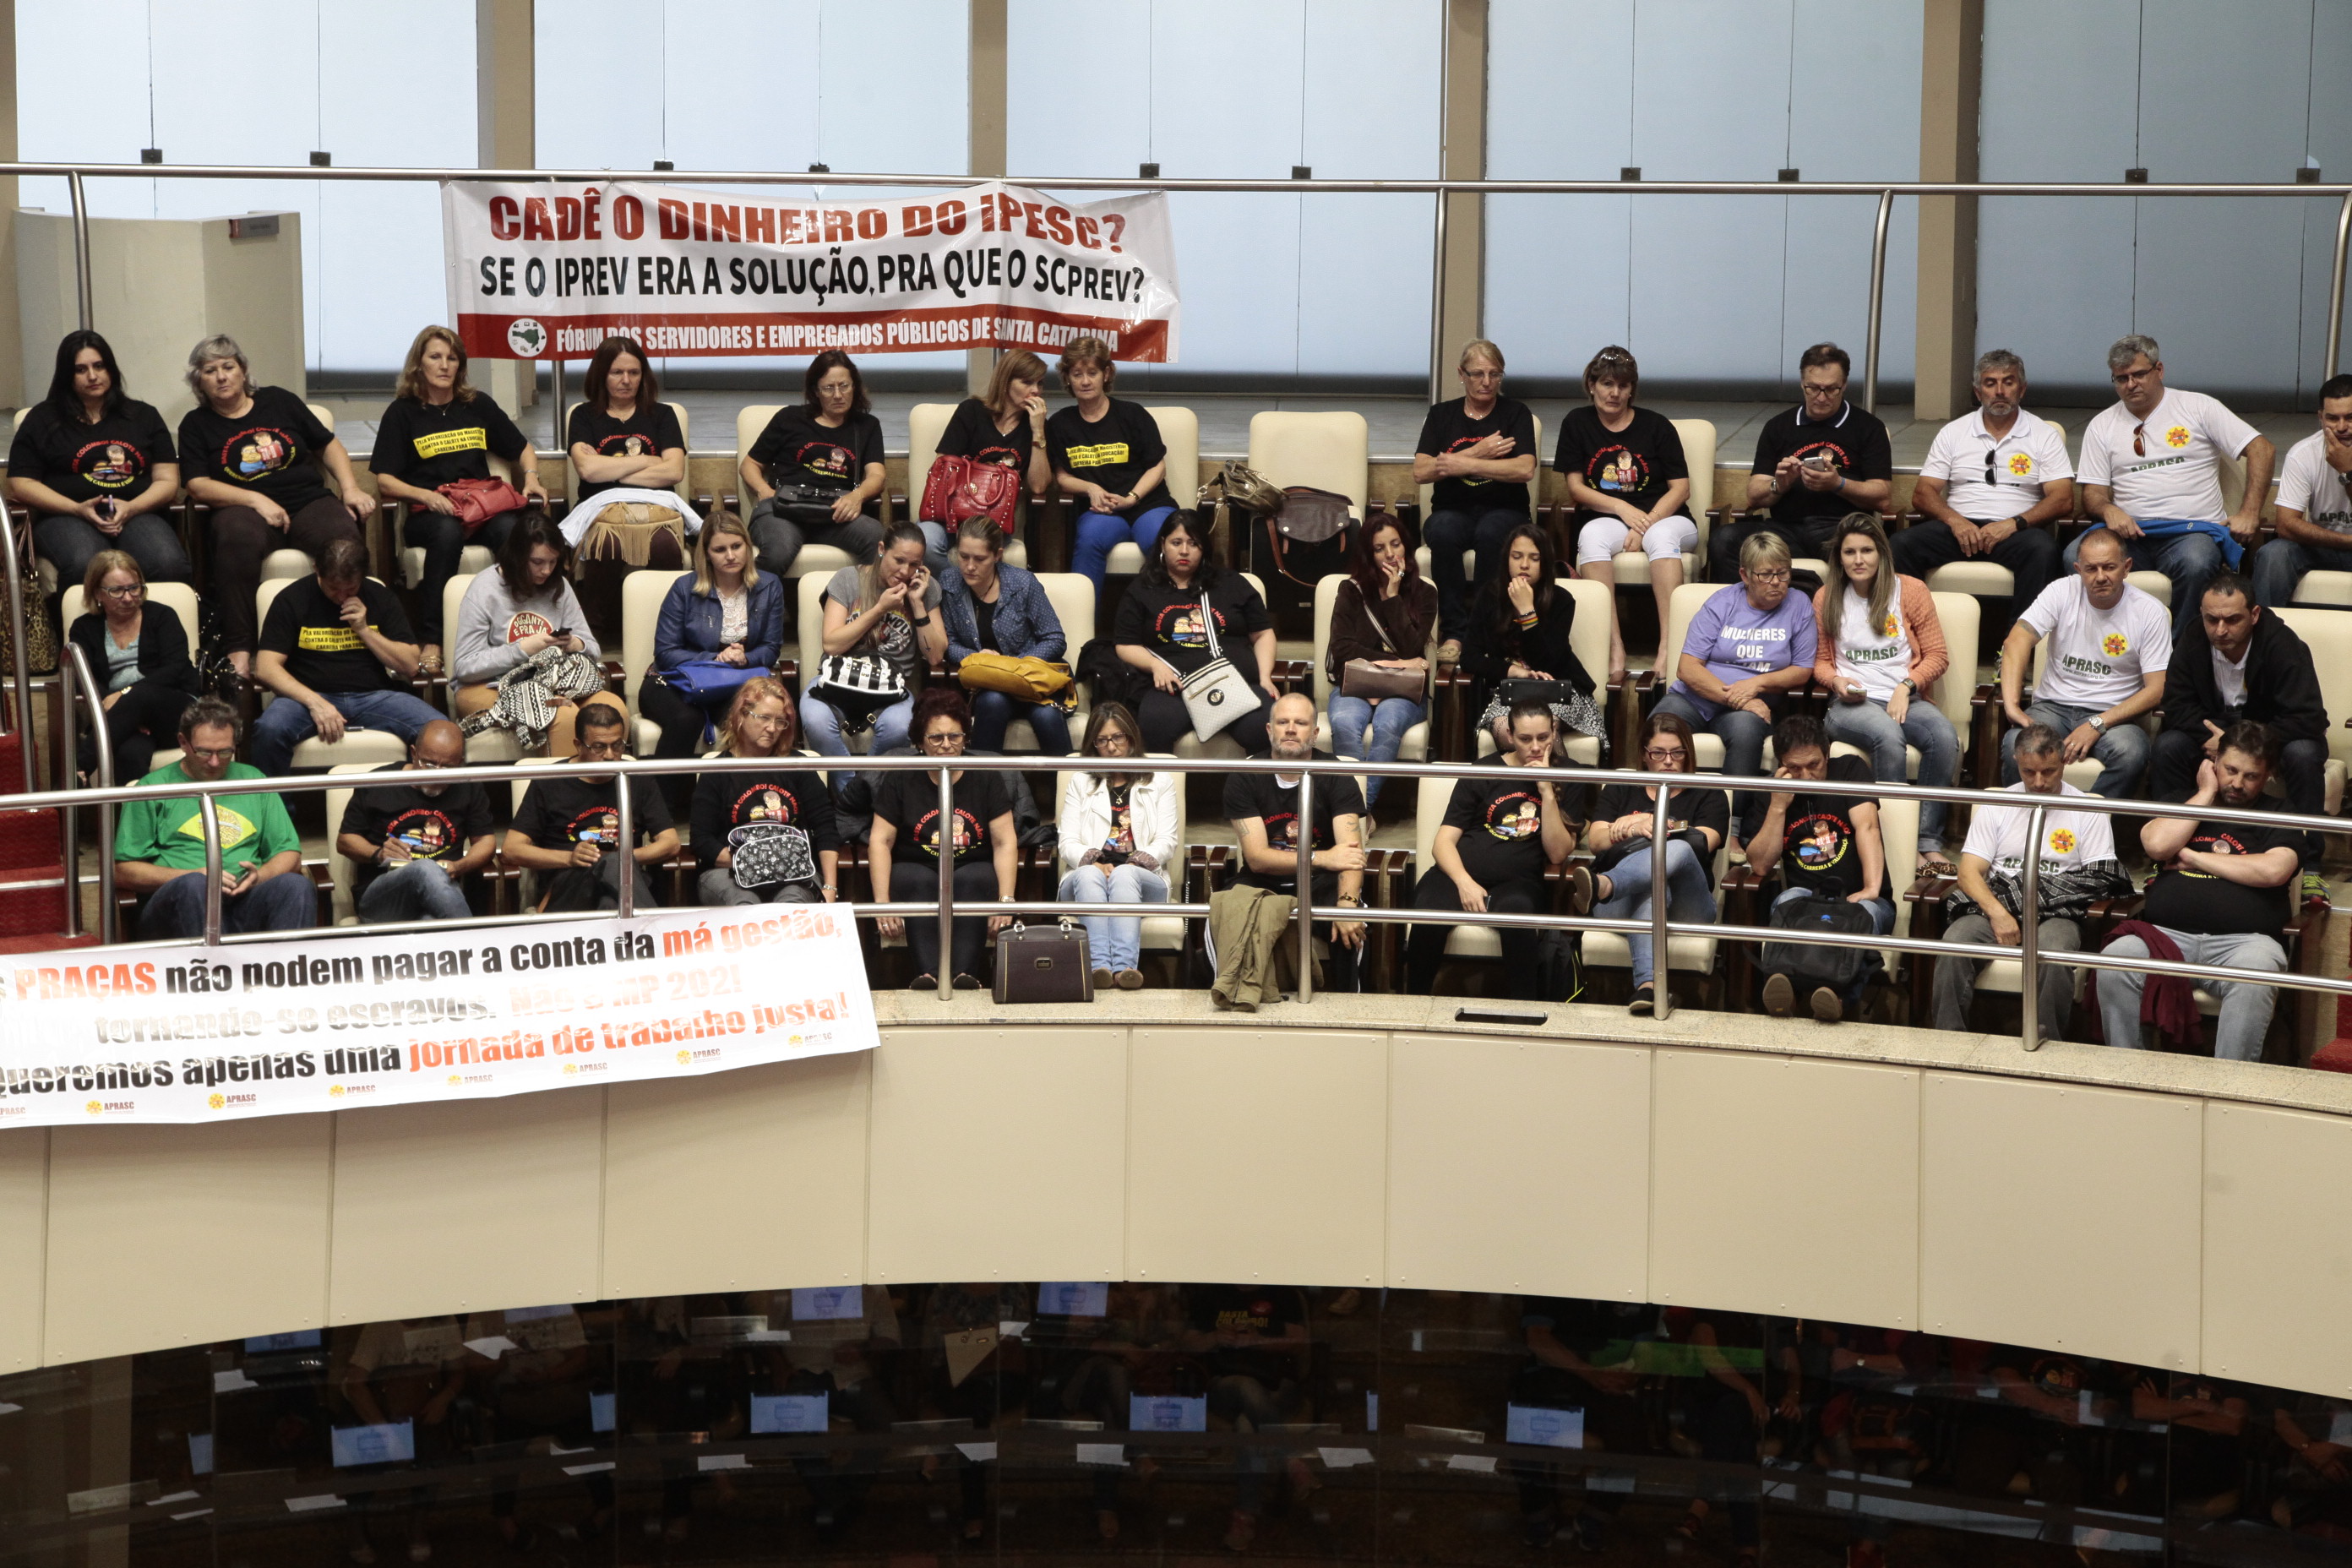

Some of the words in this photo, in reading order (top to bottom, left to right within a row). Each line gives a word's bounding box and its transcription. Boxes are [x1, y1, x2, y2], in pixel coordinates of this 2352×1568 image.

[488, 188, 602, 241] CADÊ
[612, 195, 644, 240] O
[658, 197, 888, 244] DINHEIRO
[901, 199, 966, 237] DO
[980, 192, 1126, 253] IPESC?
[480, 255, 515, 297] SE
[525, 257, 546, 297] O
[556, 256, 629, 297] IPREV
[638, 256, 696, 296] ERA
[702, 257, 723, 295] A
[944, 248, 1002, 299] QUE
[1008, 249, 1026, 288] O
[1032, 253, 1144, 304] SCPREV?
[557, 324, 603, 352] FÓRUM
[645, 325, 753, 350] SERVIDORES
[757, 326, 770, 348] E
[779, 324, 883, 348] EMPREGADOS
[887, 318, 969, 346] PÚBLICOS
[972, 317, 990, 340] DE
[994, 317, 1034, 344] SANTA
[519, 625, 535, 634] PRA
[1720, 625, 1786, 641] MULHERES
[1736, 645, 1764, 659] QUE
[1845, 646, 1898, 661] APRASC
[2062, 653, 2111, 675] APRASC
[738, 783, 767, 803] COLOMBO!
[769, 784, 792, 798] CALOTE
[1527, 796, 1542, 806] CALO
[920, 808, 940, 824] COLO
[954, 808, 977, 824] CALOTE
[2220, 833, 2244, 851] CALOTE
[2003, 858, 2061, 874] APSC
[14, 961, 157, 1002] PRAÇAS
[168, 958, 232, 994] não
[242, 954, 363, 994] podem
[372, 947, 473, 986] pagar
[482, 945, 503, 973] a
[510, 934, 606, 971] conta
[614, 931, 655, 962] da
[662, 922, 716, 956] má
[721, 908, 842, 953] gestão,
[95, 1005, 318, 1044] tornando-se
[327, 993, 497, 1031] escravos.
[509, 983, 574, 1017] Não
[612, 974, 660, 1006] MP
[667, 964, 743, 1000] 202!
[182, 1050, 316, 1087] apenas
[324, 1043, 401, 1075] uma
[409, 1027, 546, 1073] jornada
[552, 1024, 595, 1055] de
[601, 1009, 746, 1049] trabalho
[753, 991, 850, 1035] justa!
[693, 1048, 721, 1059] APRASC
[580, 1062, 608, 1073] APRASC
[464, 1075, 493, 1085] APRASC
[347, 1085, 376, 1094] APRASC
[104, 1102, 134, 1111] APRASC
[226, 1094, 257, 1103] APRASC
[1216, 1317, 1269, 1329] COLBO!
